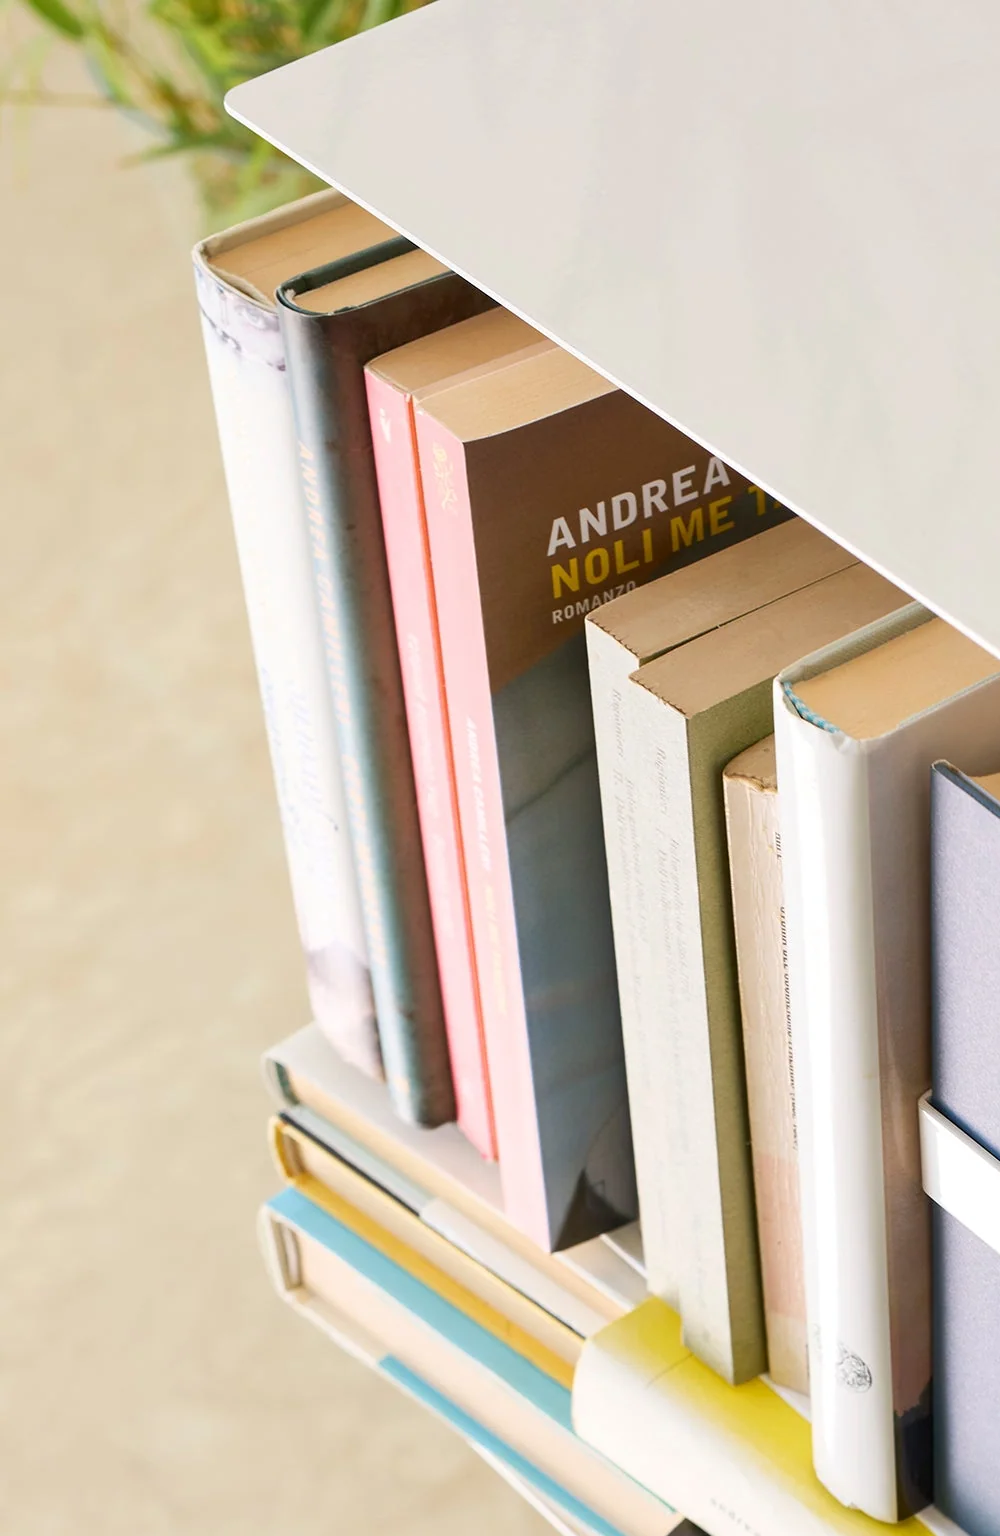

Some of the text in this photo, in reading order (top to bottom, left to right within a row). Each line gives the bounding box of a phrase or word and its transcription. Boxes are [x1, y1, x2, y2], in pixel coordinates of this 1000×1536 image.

[547, 456, 732, 557] ANDREA
[551, 485, 782, 600] NOLI ME T
